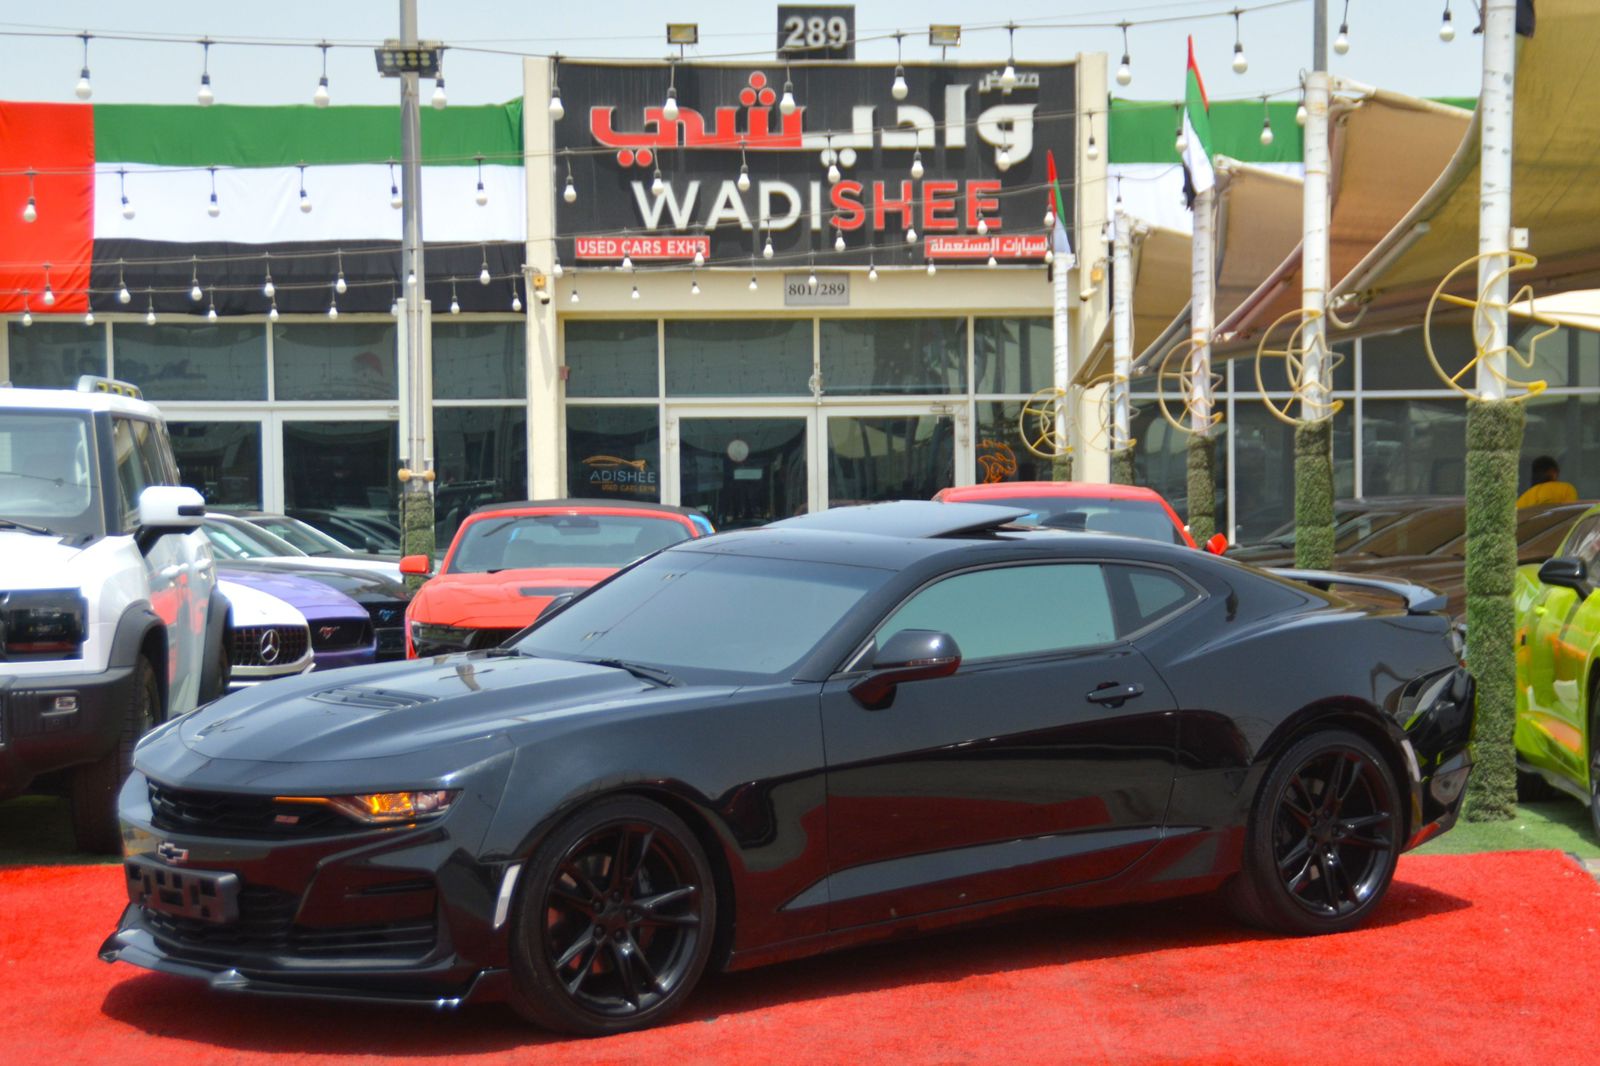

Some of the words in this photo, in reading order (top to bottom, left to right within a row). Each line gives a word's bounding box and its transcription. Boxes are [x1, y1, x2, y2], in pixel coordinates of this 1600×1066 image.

[783, 15, 847, 48] 289
[577, 240, 617, 254] USED
[621, 240, 661, 254] CARS
[930, 237, 999, 253] المستعملة
[788, 282, 846, 296] 801/289
